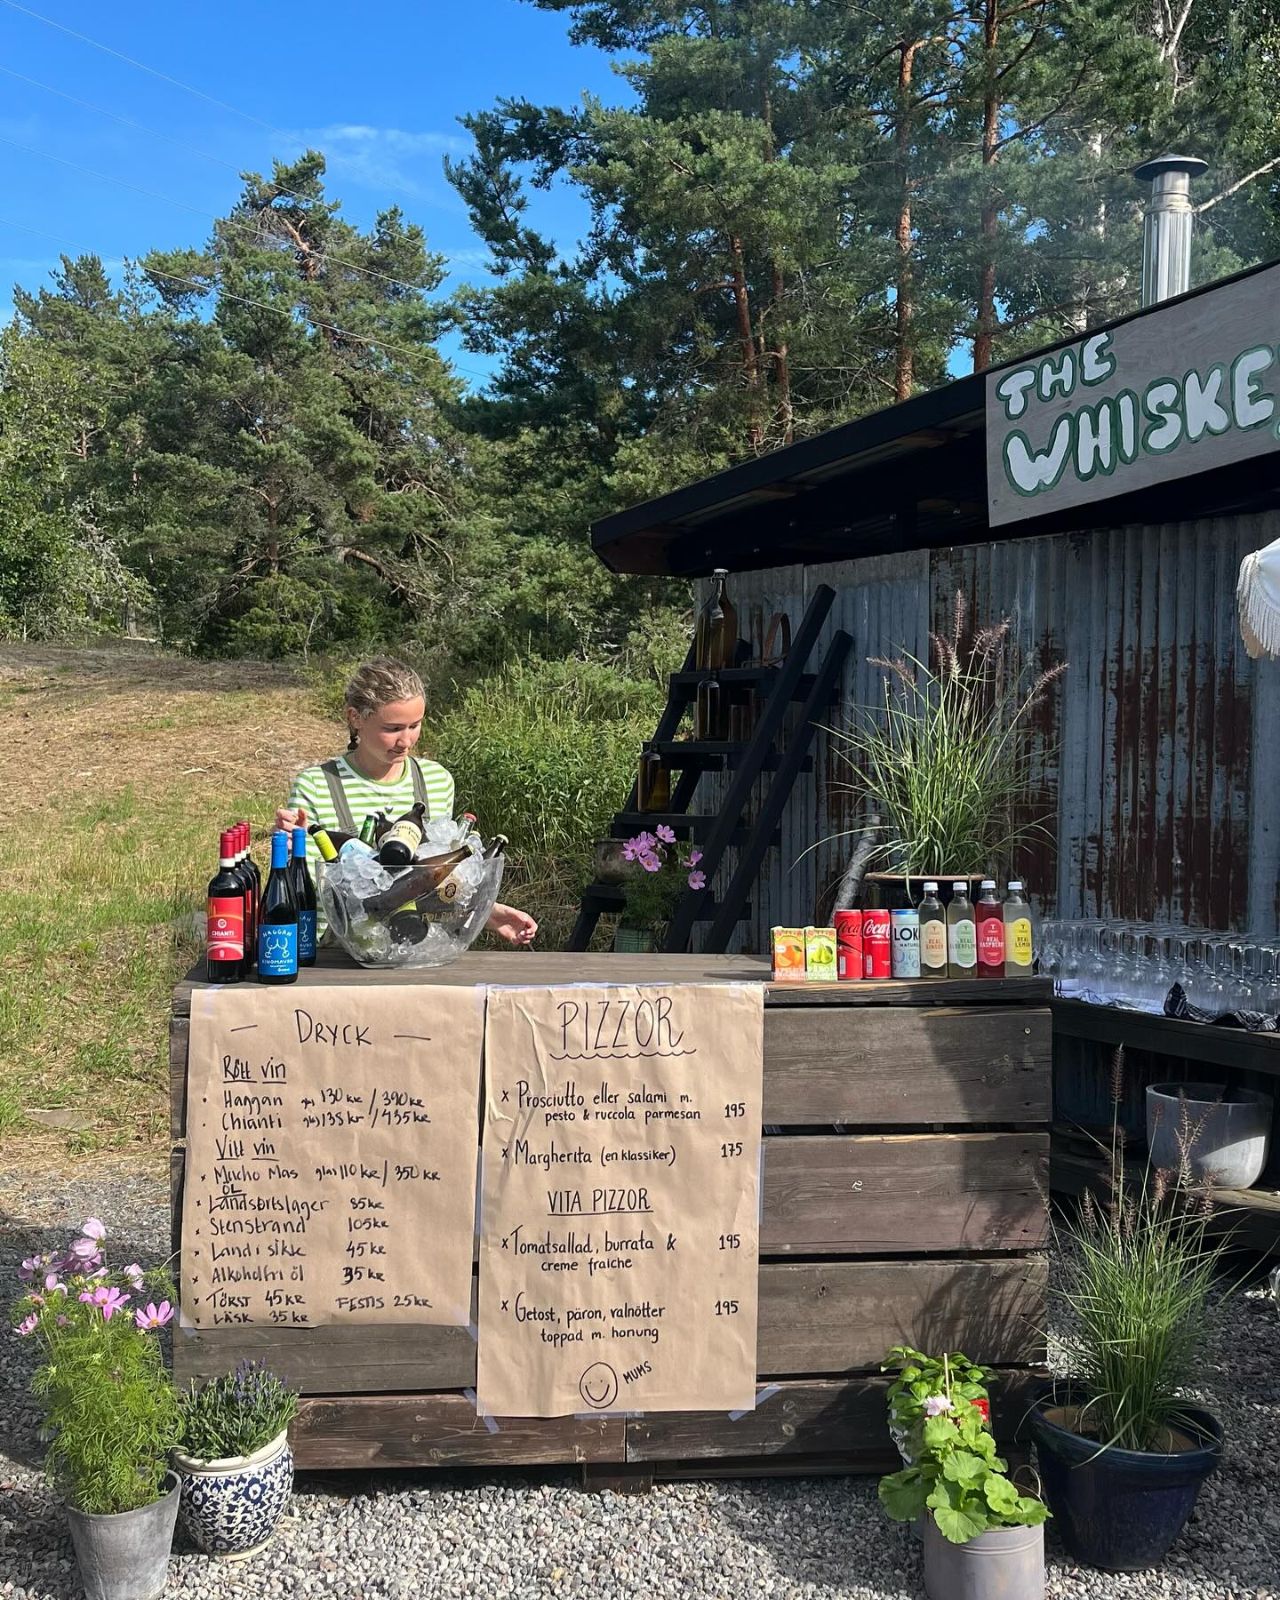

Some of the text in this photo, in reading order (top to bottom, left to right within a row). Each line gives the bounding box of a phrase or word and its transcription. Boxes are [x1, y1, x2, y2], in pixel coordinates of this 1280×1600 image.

[996, 331, 1117, 420] THE
[1003, 345, 1280, 497] WHISKE
[262, 929, 293, 937] HAGGAN
[894, 927, 919, 940] LOK
[295, 1009, 372, 1046] DRYCK
[557, 996, 684, 1050] PIZZOR
[261, 1056, 286, 1078] vin
[224, 1090, 283, 1115] Haggan
[320, 1087, 343, 1104] 130
[516, 1080, 585, 1108] Prosciutto
[593, 1082, 619, 1104] eller
[627, 1084, 667, 1104] salami
[222, 1113, 282, 1131] Chianti
[322, 1112, 344, 1127] 135
[545, 1112, 575, 1126] pesto
[595, 1106, 635, 1120] ruccola
[645, 1110, 700, 1125] parmesan
[724, 1103, 745, 1118] 195
[253, 1137, 275, 1155] vin
[515, 1140, 592, 1171] Margherita
[721, 1143, 742, 1157] 175
[214, 1164, 260, 1184] Mucho
[268, 1164, 299, 1180] Mas
[395, 1165, 420, 1181] 350
[222, 1181, 242, 1195] ÖL
[548, 1187, 650, 1213] VITA PIZZOR
[210, 1216, 306, 1236] Stenstrand
[211, 1242, 252, 1261] Land
[346, 1241, 368, 1258] 45
[510, 1225, 599, 1255] Tomatsallad,
[605, 1230, 654, 1251] burrata
[719, 1234, 740, 1250] 195
[290, 1265, 304, 1281] öl
[541, 1257, 633, 1276] creme fraiche
[265, 1289, 284, 1306] 45
[269, 1310, 288, 1323] 35
[515, 1292, 561, 1324] Getost,
[566, 1308, 607, 1328] päron,
[610, 1302, 665, 1318] valnötter
[715, 1301, 739, 1316] 195
[541, 1329, 583, 1348] toppad
[611, 1326, 659, 1344] honung
[622, 1360, 653, 1385] MUMS
